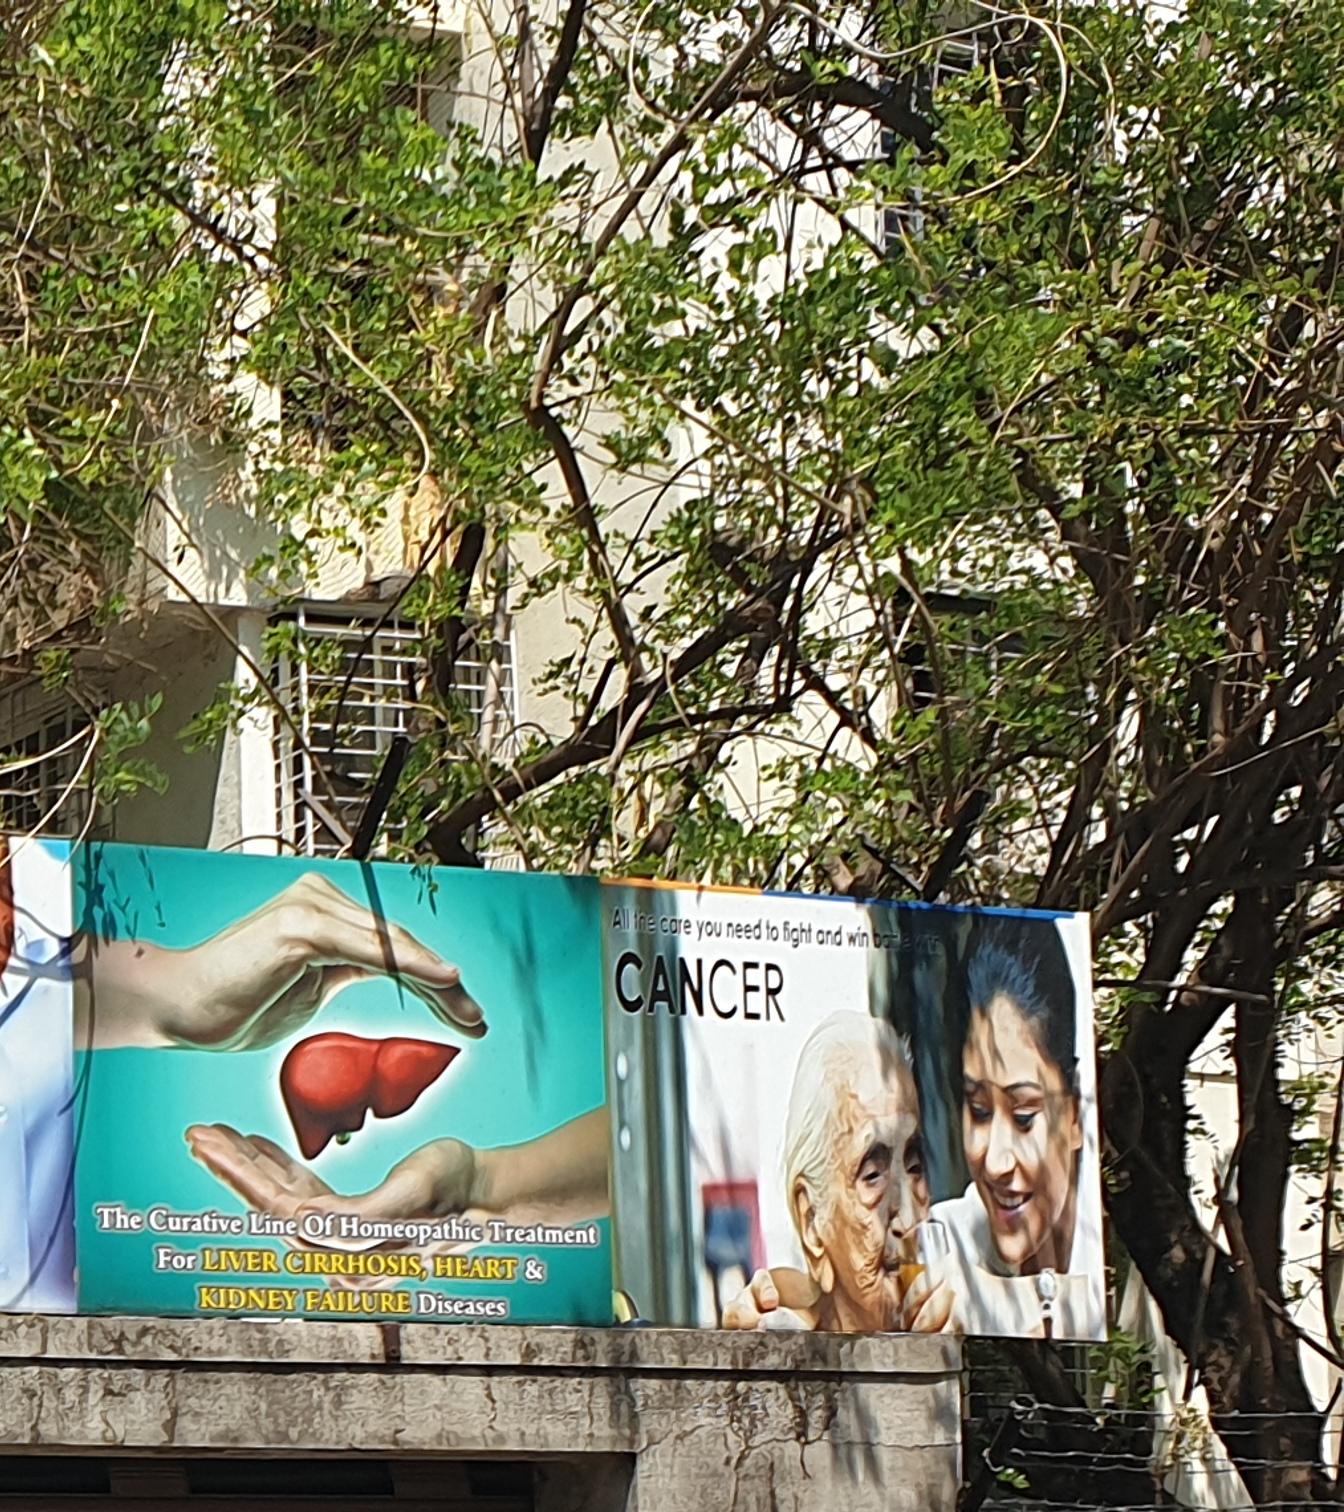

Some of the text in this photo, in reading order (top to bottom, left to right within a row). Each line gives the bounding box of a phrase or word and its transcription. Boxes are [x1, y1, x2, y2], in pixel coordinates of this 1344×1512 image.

[697, 921, 721, 941] you
[727, 919, 761, 940] need
[766, 920, 779, 941] to
[783, 921, 812, 948] fight
[816, 926, 842, 946] and
[847, 927, 869, 948] win
[614, 951, 786, 1024] CANCER
[93, 1203, 599, 1247] The Curative Line Of Homeopathic Treatment
[155, 1247, 517, 1281] For LIVER CIRRHOSIS, HEART
[199, 1286, 507, 1318] KIDNEY FAILURE Diseases
